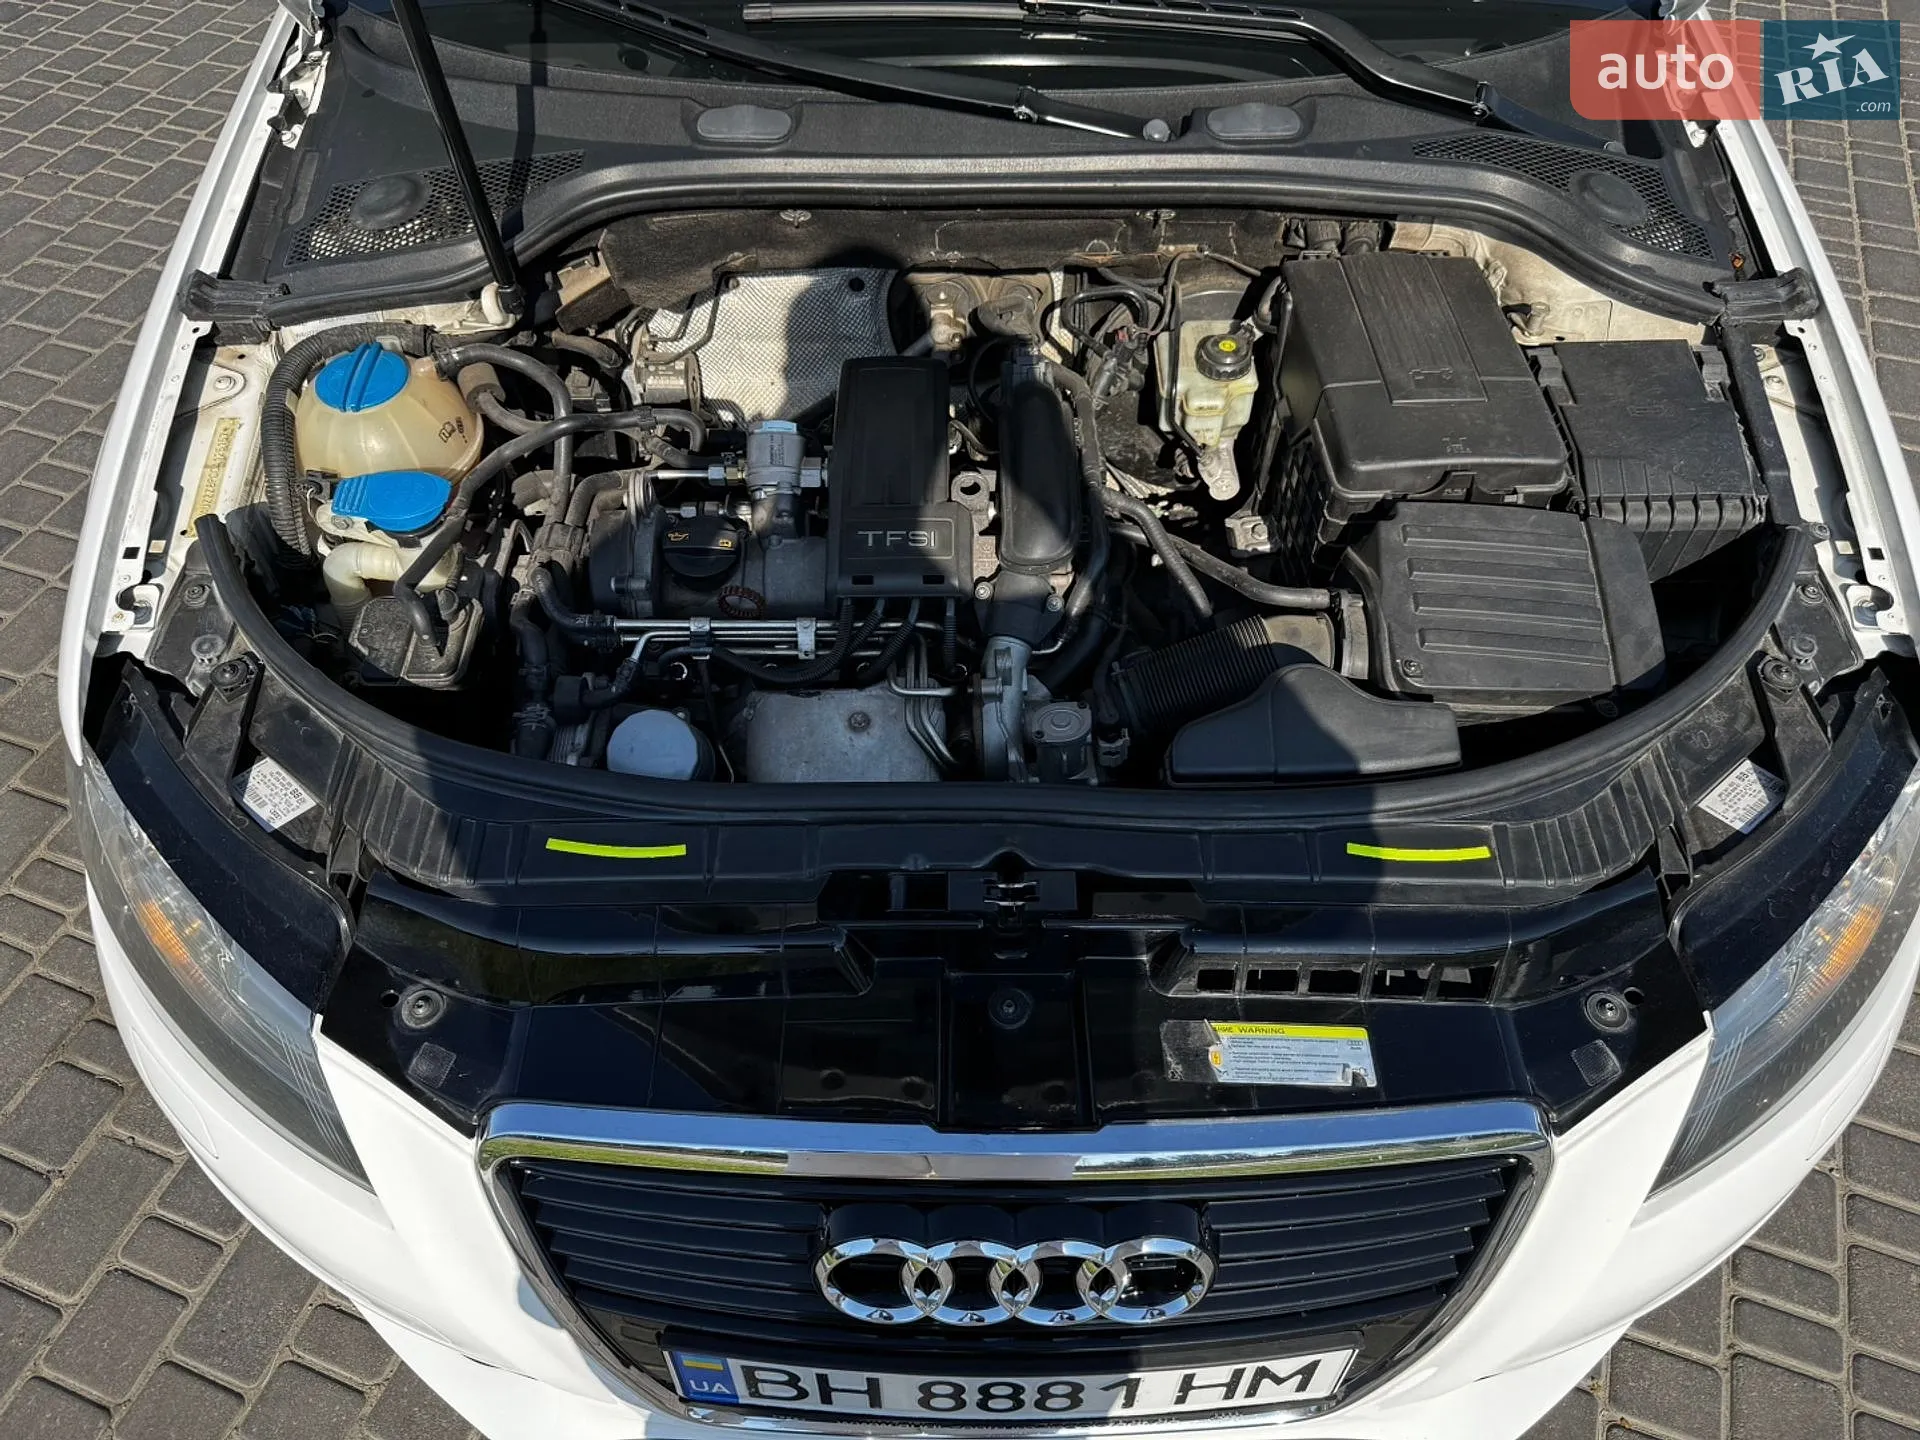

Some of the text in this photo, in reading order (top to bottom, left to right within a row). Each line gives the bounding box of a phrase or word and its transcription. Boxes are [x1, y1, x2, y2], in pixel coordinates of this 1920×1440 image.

[857, 530, 935, 547] TFSI
[1239, 1025, 1285, 1035] WARNING
[690, 1379, 730, 1395] UA
[740, 1358, 1321, 1412] BH 8881 HM
